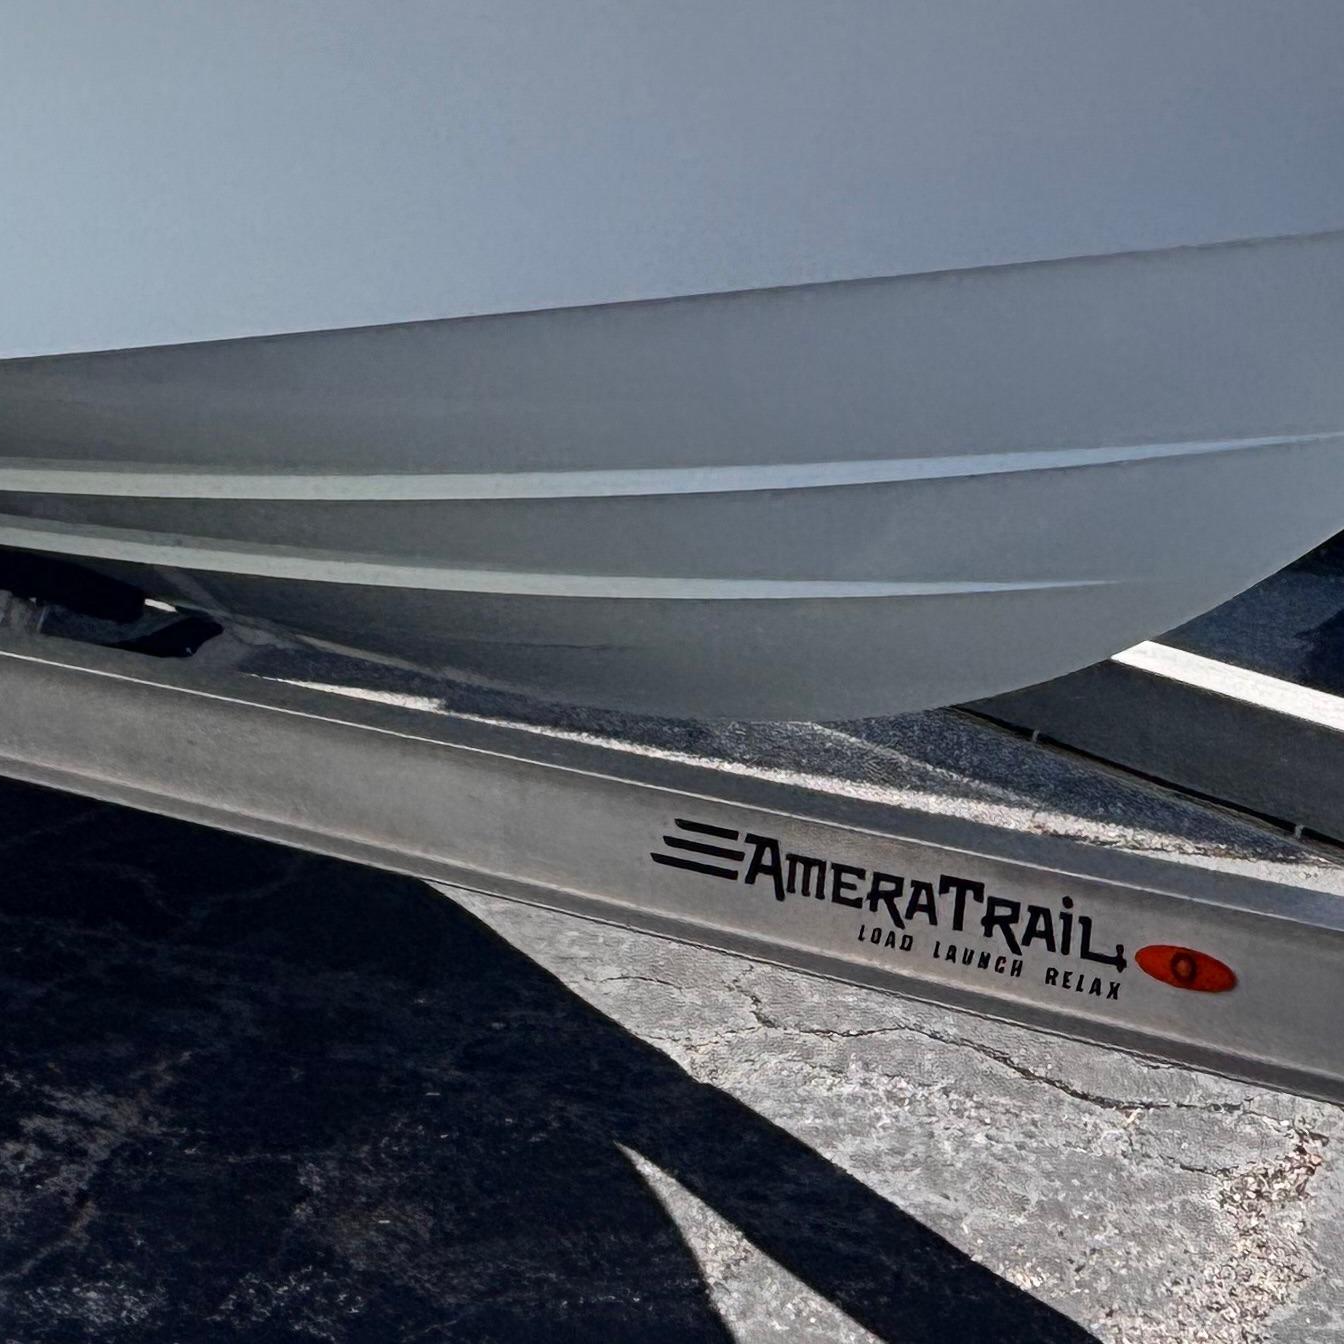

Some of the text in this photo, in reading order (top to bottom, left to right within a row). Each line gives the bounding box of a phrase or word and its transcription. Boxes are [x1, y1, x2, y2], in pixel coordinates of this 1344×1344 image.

[857, 924, 1122, 1001] LOAD LAUNCH RELAX
